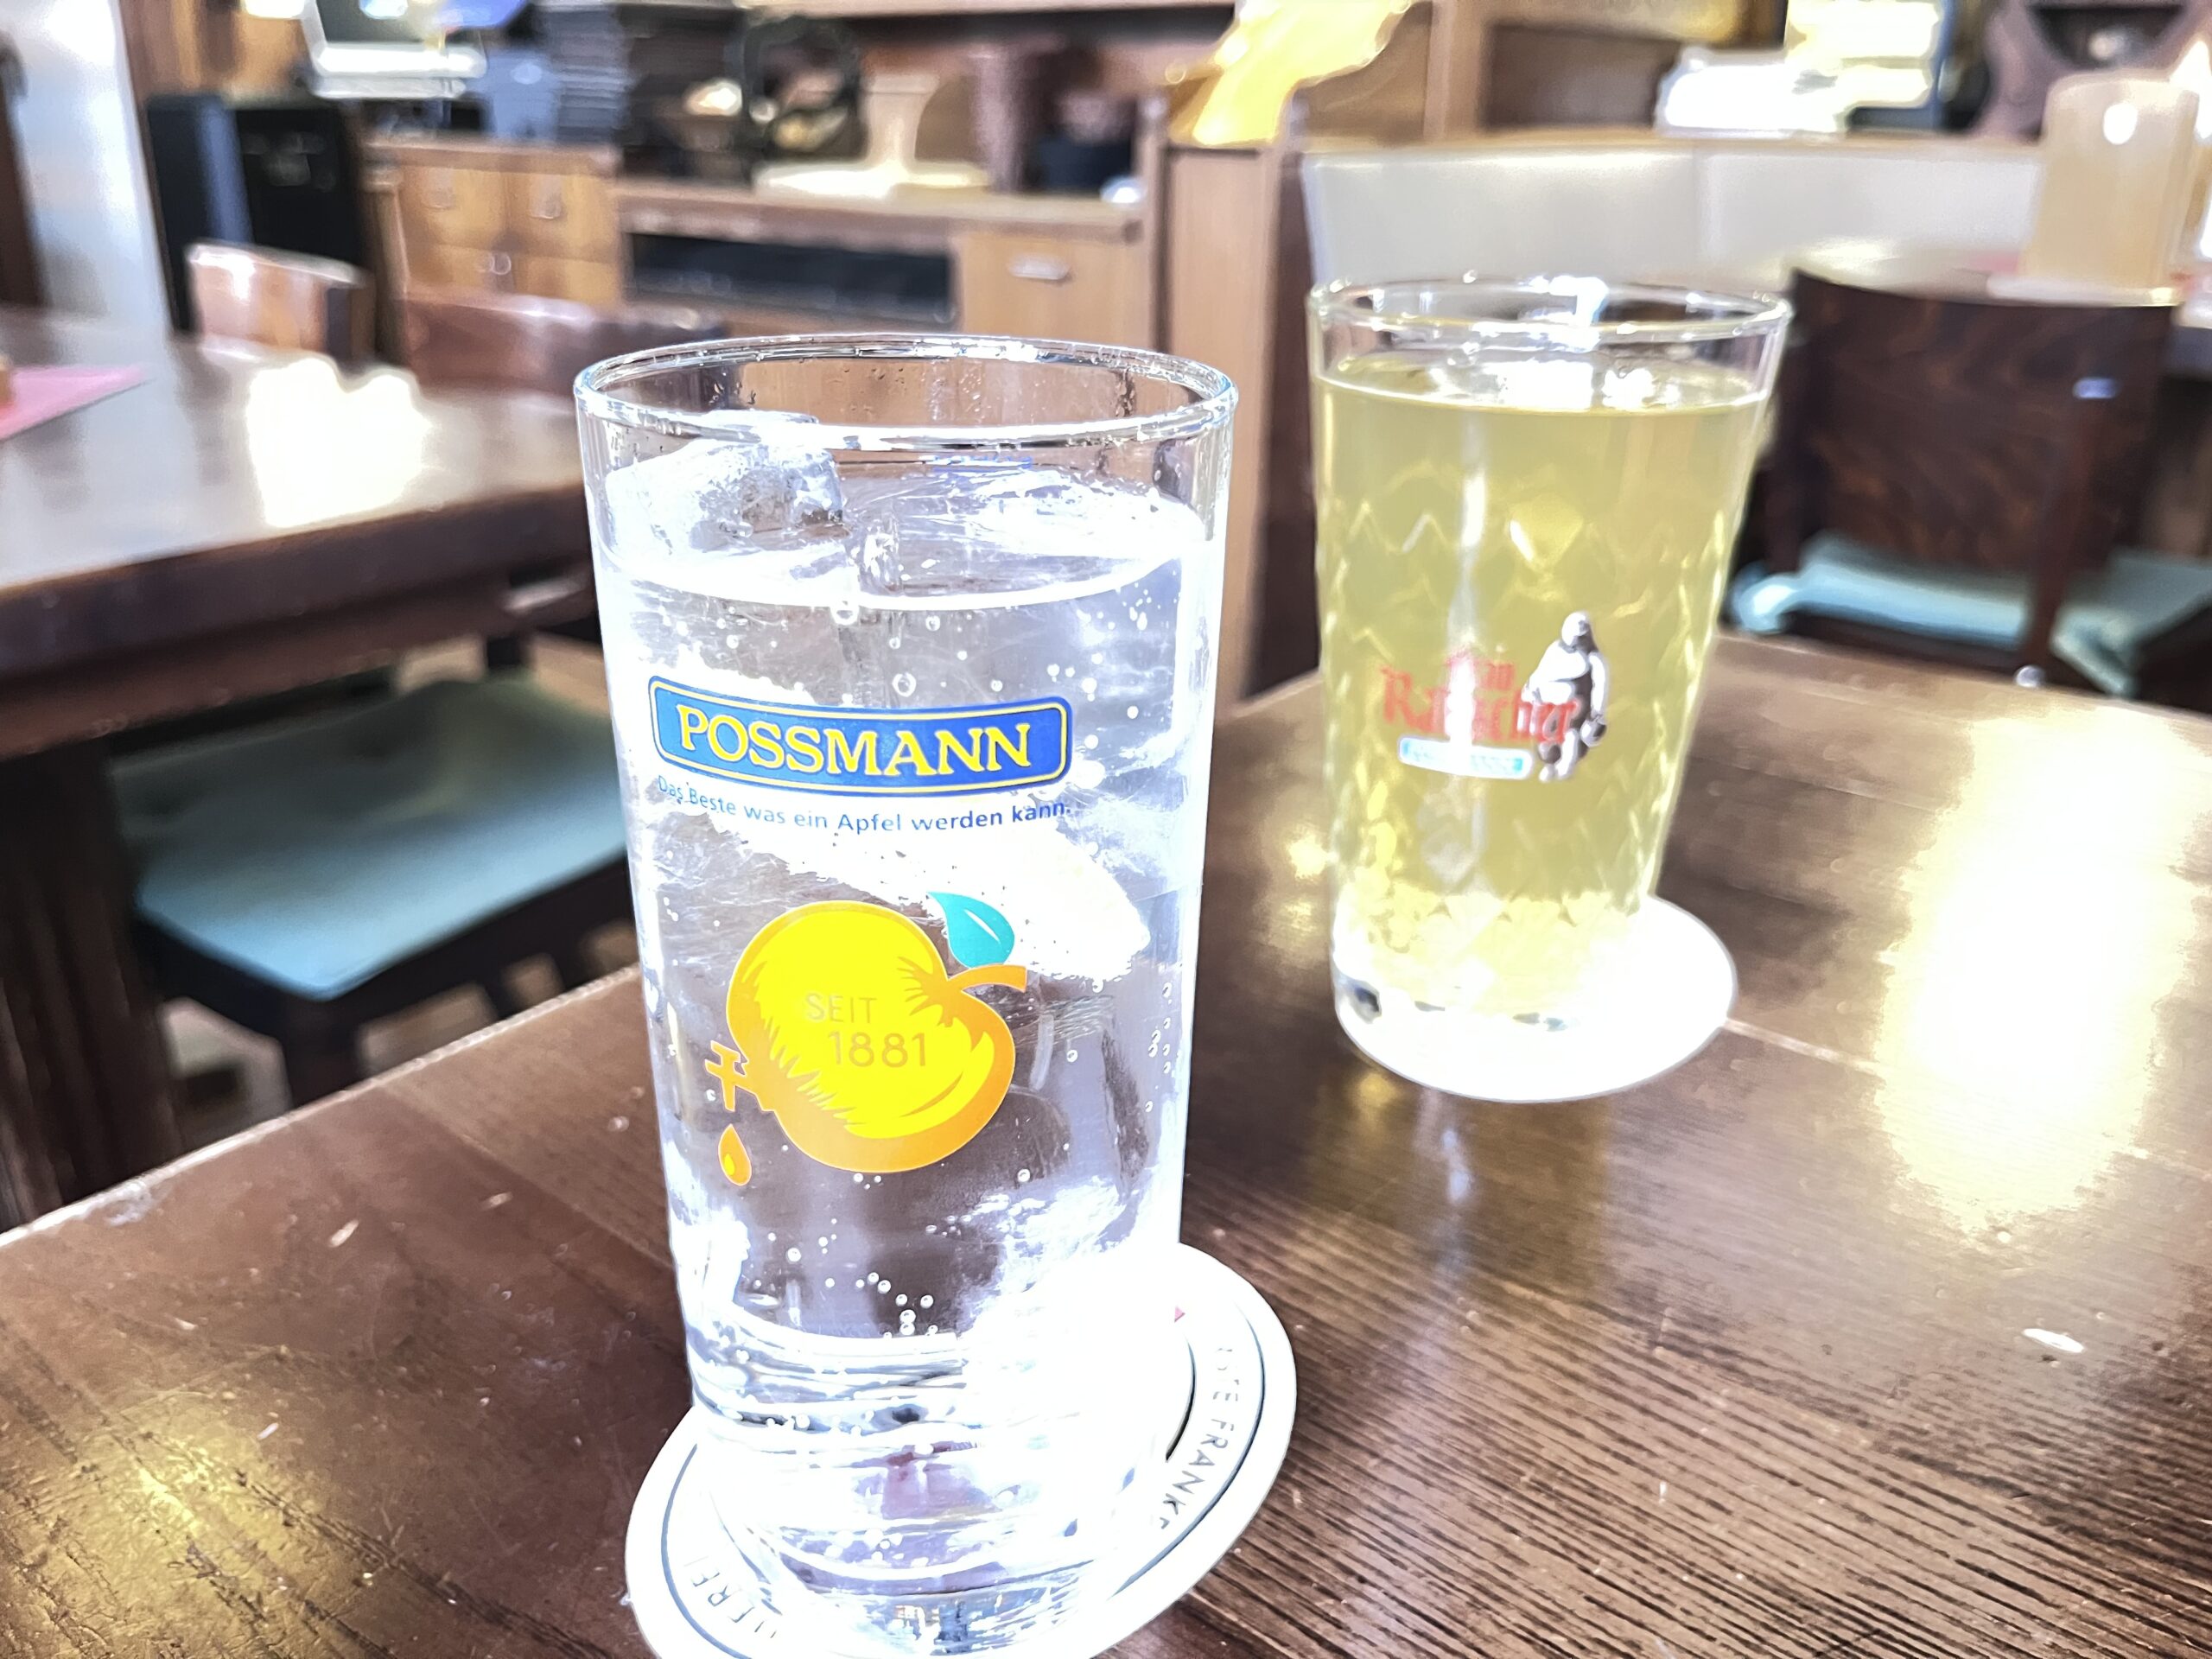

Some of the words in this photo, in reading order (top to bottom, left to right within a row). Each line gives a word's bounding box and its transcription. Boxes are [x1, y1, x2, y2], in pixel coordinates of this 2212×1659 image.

[677, 703, 1032, 776] POSSMANN
[658, 775, 683, 801] Das
[689, 786, 736, 815] Beste
[743, 804, 785, 824] was
[794, 810, 828, 829] ein
[838, 813, 902, 835] Apfel
[912, 810, 1002, 831] werden
[1012, 802, 1071, 823] kann.
[805, 992, 879, 1024] SEIT
[828, 1031, 926, 1068] 1881
